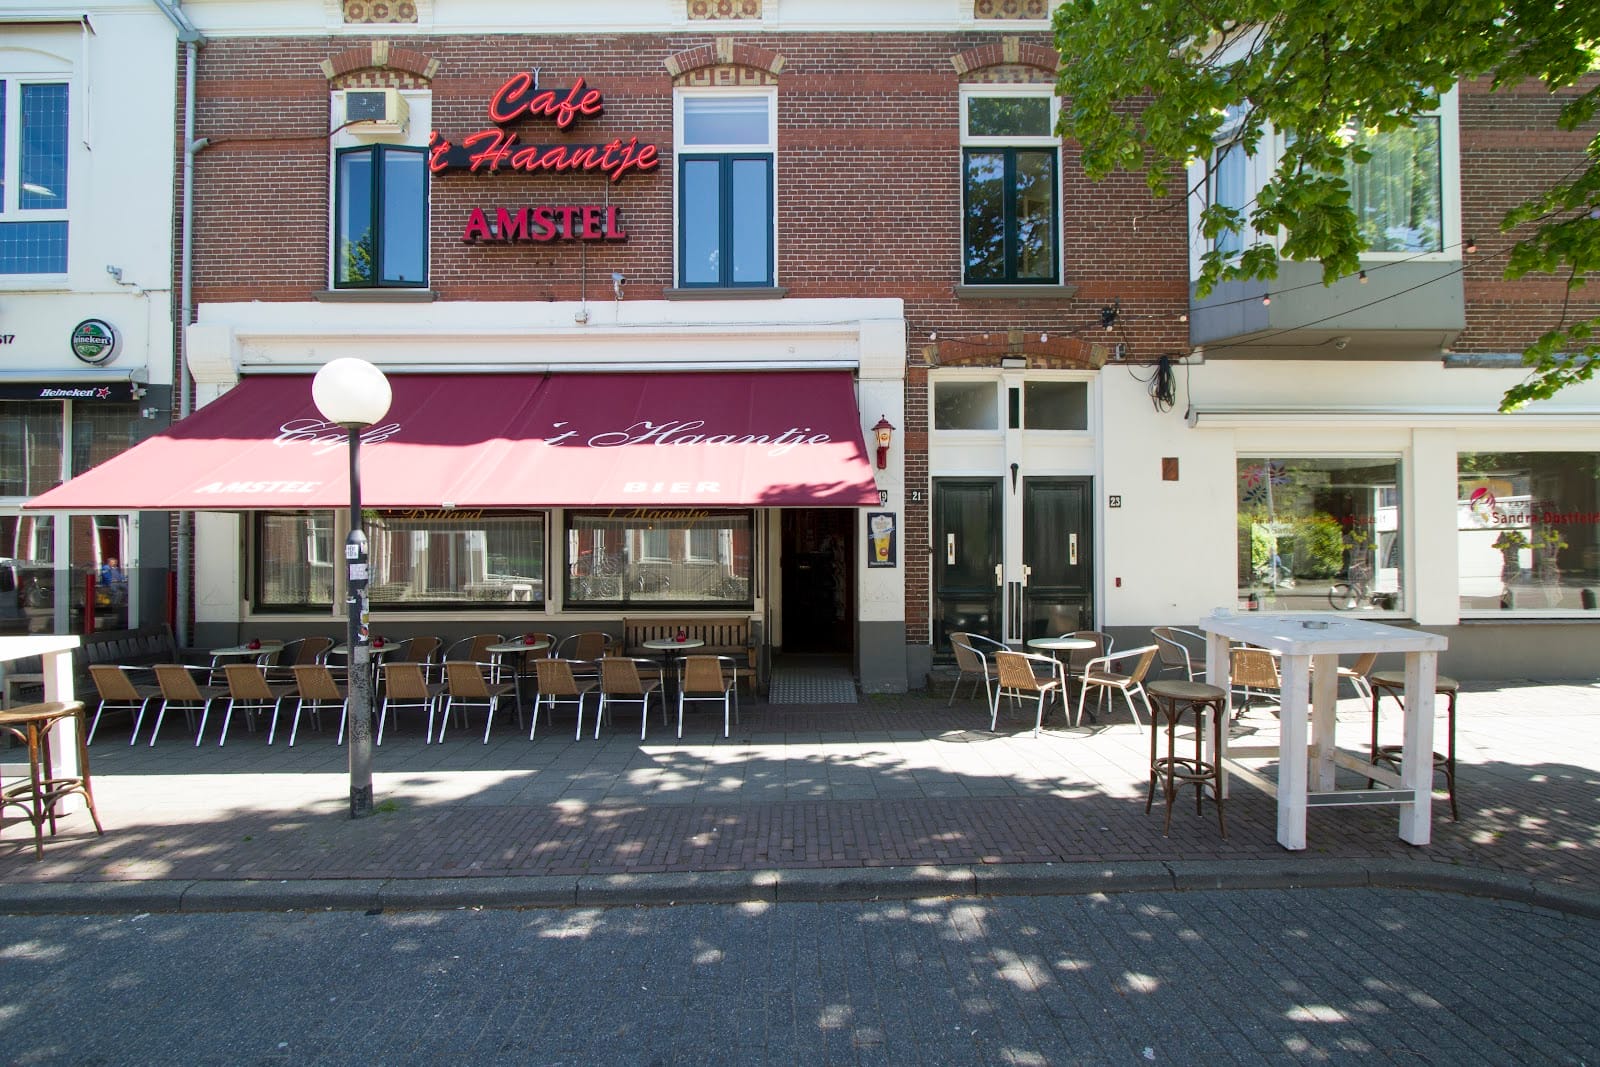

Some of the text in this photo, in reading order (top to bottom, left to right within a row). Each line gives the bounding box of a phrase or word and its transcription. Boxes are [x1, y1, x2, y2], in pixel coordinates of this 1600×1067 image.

[488, 72, 602, 129] Cafe
[463, 127, 659, 182] Haantje
[462, 205, 628, 242] AMSTEL
[40, 387, 95, 397] Heineken
[587, 420, 831, 457] Haantje
[194, 480, 721, 493] AMSTEL BIER
[912, 491, 921, 501] 21
[1110, 496, 1121, 507] 23
[1491, 511, 1539, 524] Sandra
